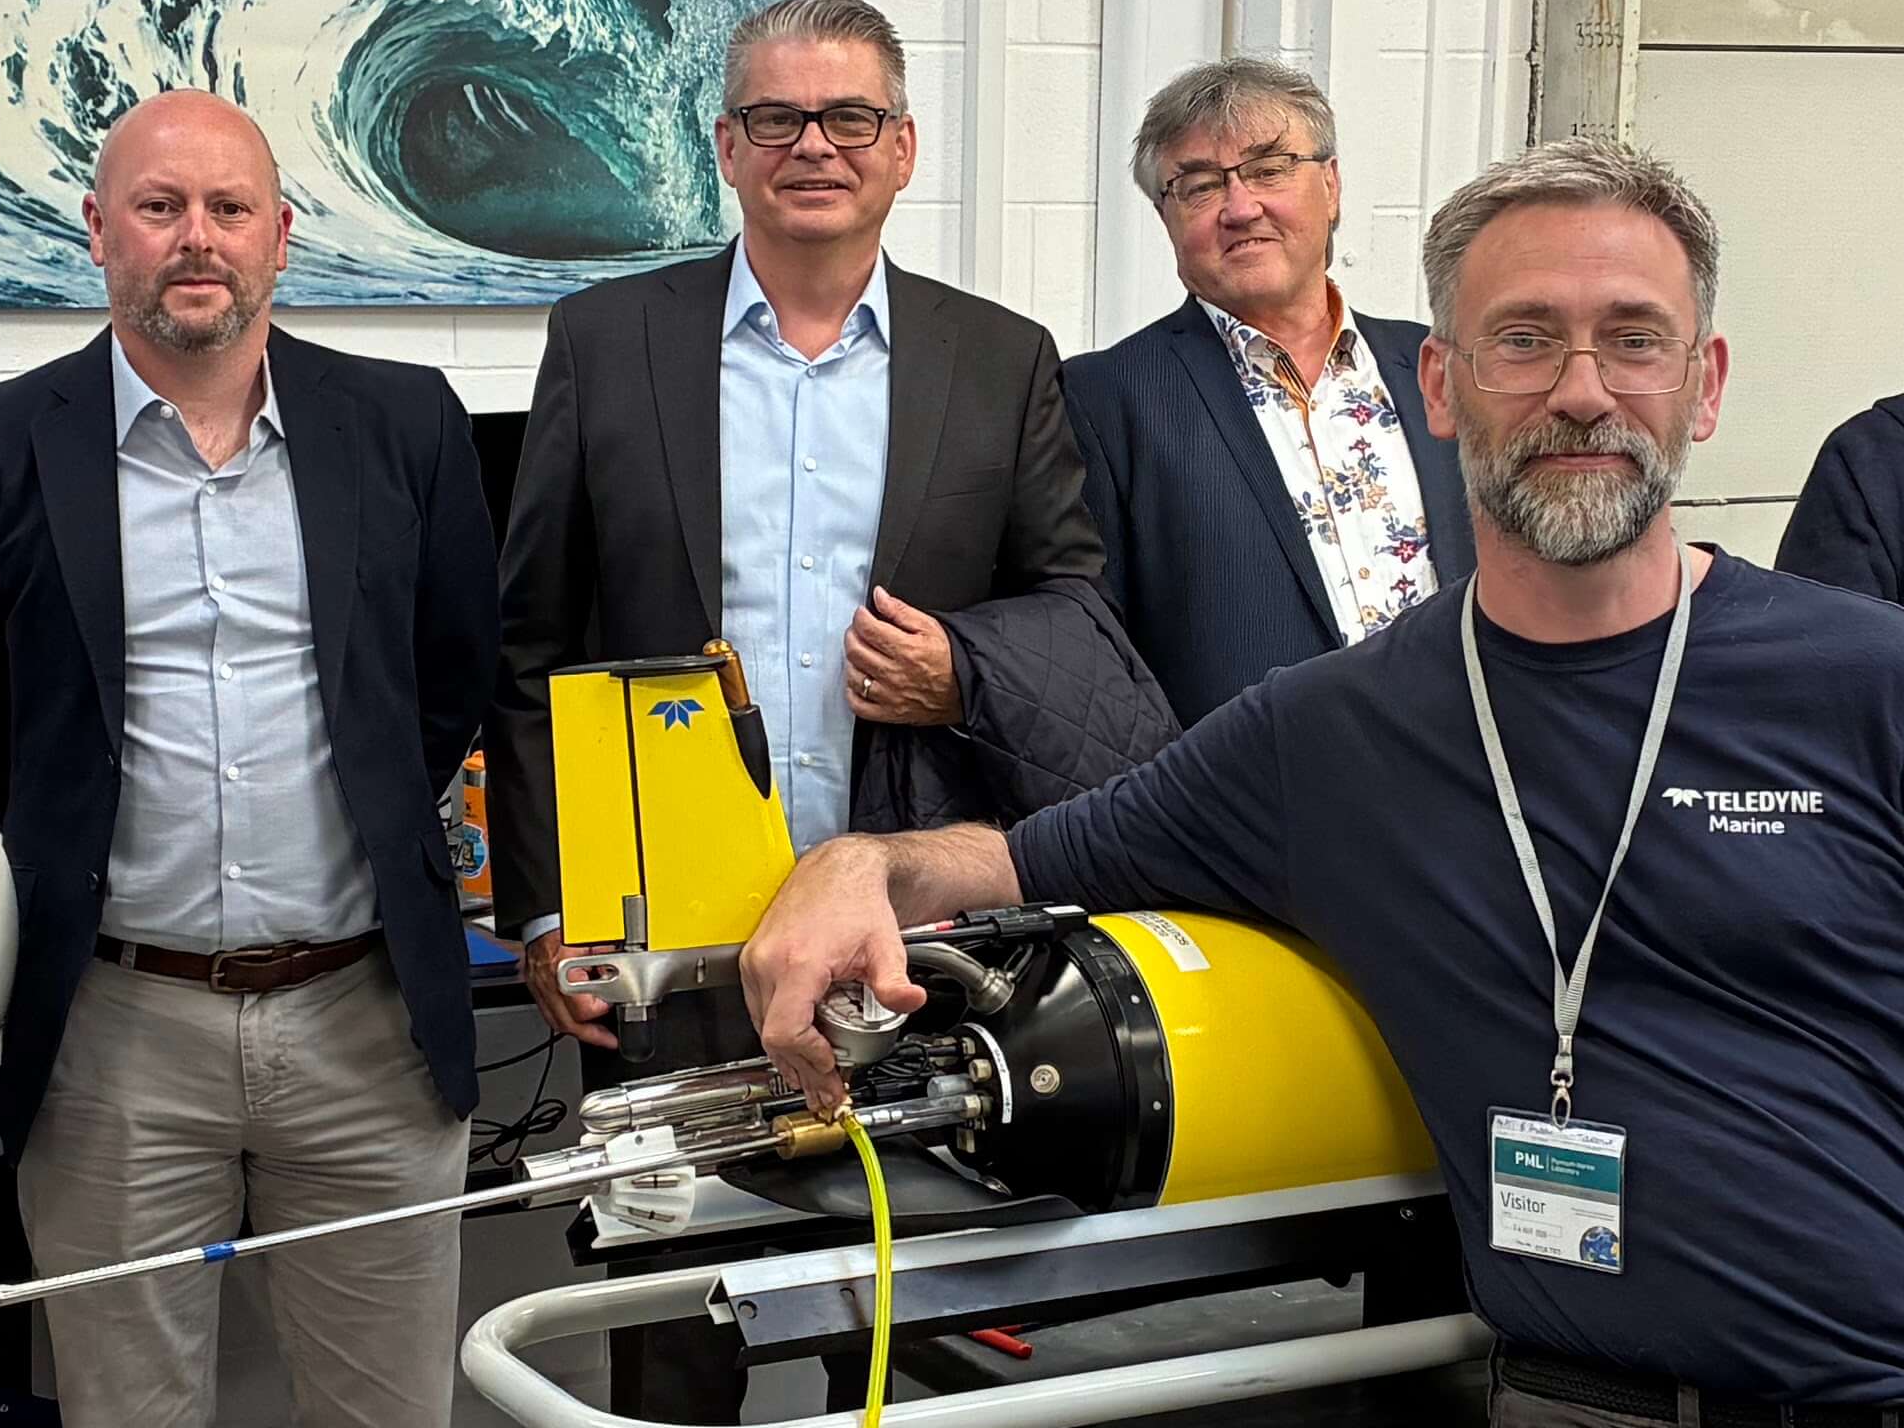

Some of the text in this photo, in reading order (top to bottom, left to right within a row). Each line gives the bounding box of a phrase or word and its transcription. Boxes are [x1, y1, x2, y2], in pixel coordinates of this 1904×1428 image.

[1703, 791, 1824, 814] TELEDYNE
[1709, 815, 1785, 834] Marine
[1514, 1151, 1545, 1170] PML
[1500, 1190, 1546, 1214] Visitor
